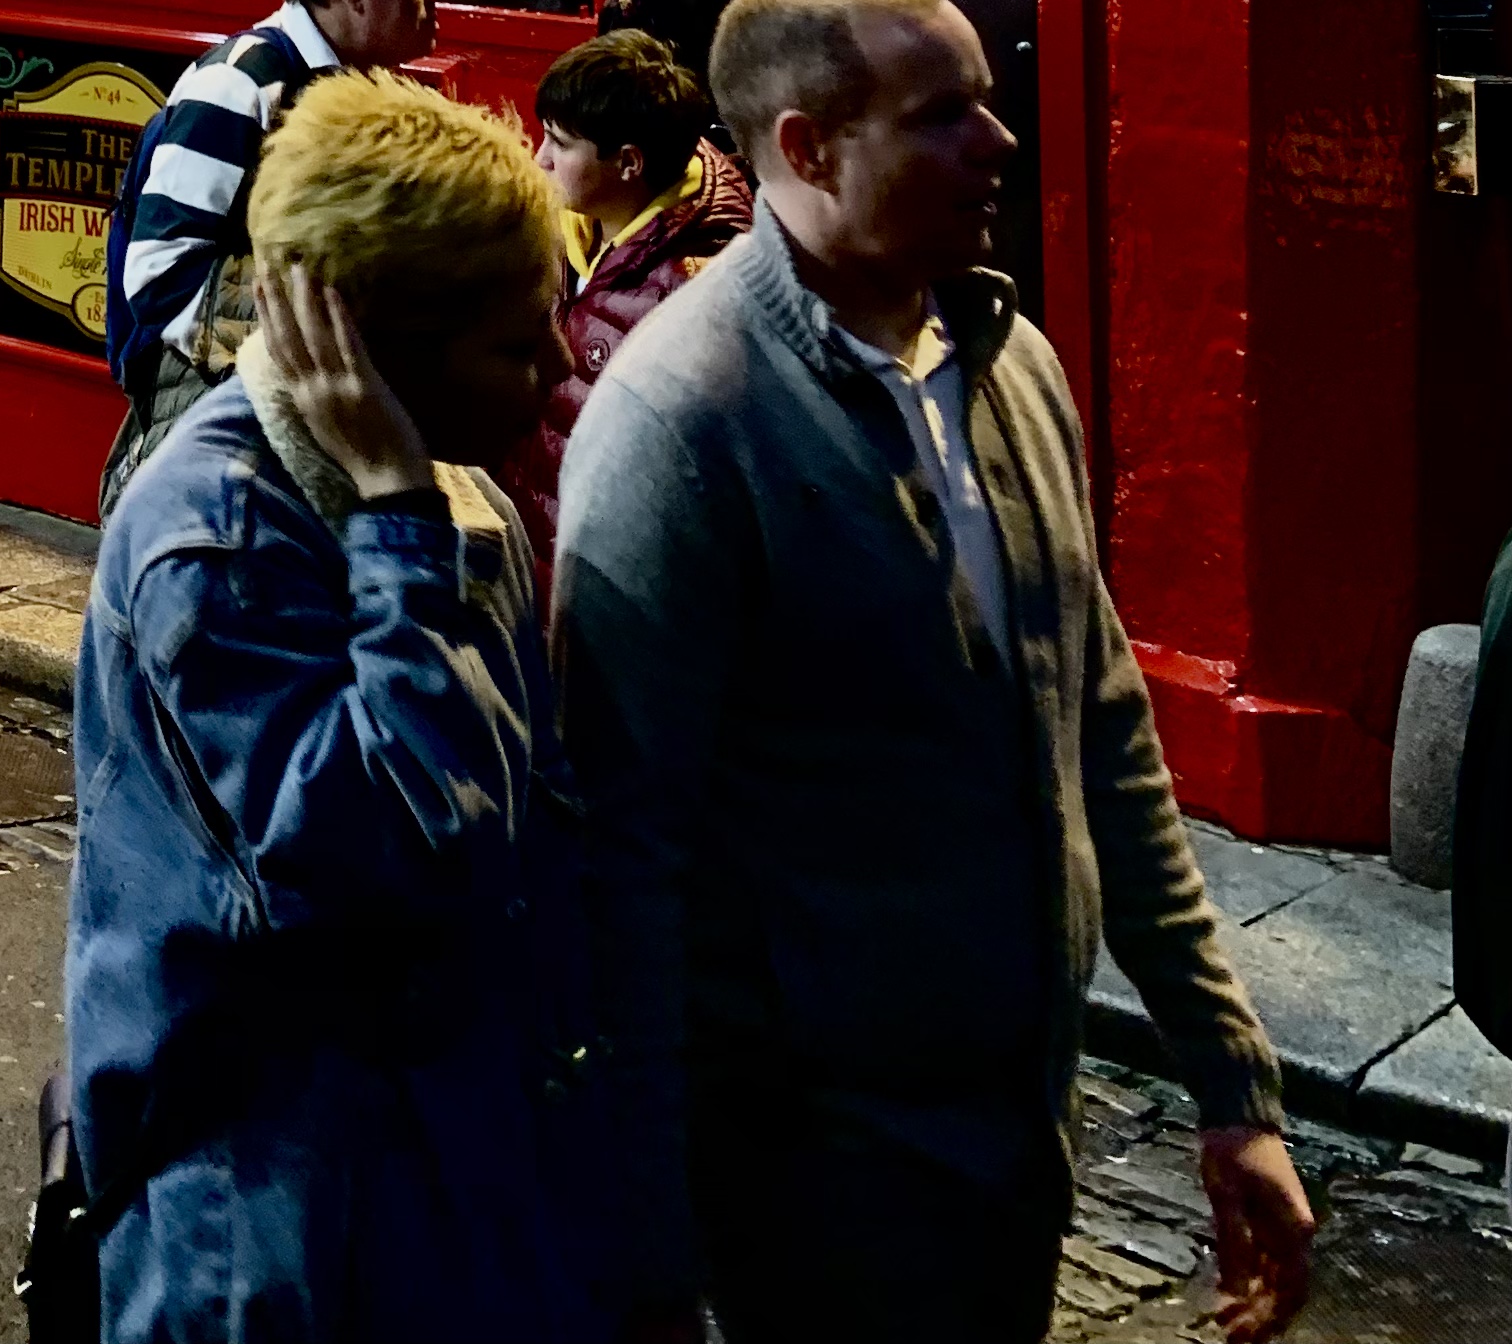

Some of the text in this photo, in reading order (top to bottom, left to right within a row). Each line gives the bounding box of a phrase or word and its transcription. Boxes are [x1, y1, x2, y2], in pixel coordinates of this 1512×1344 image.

[81, 129, 133, 162] THE
[19, 202, 75, 234] IRISH
[18, 266, 53, 290] DUBLIN
